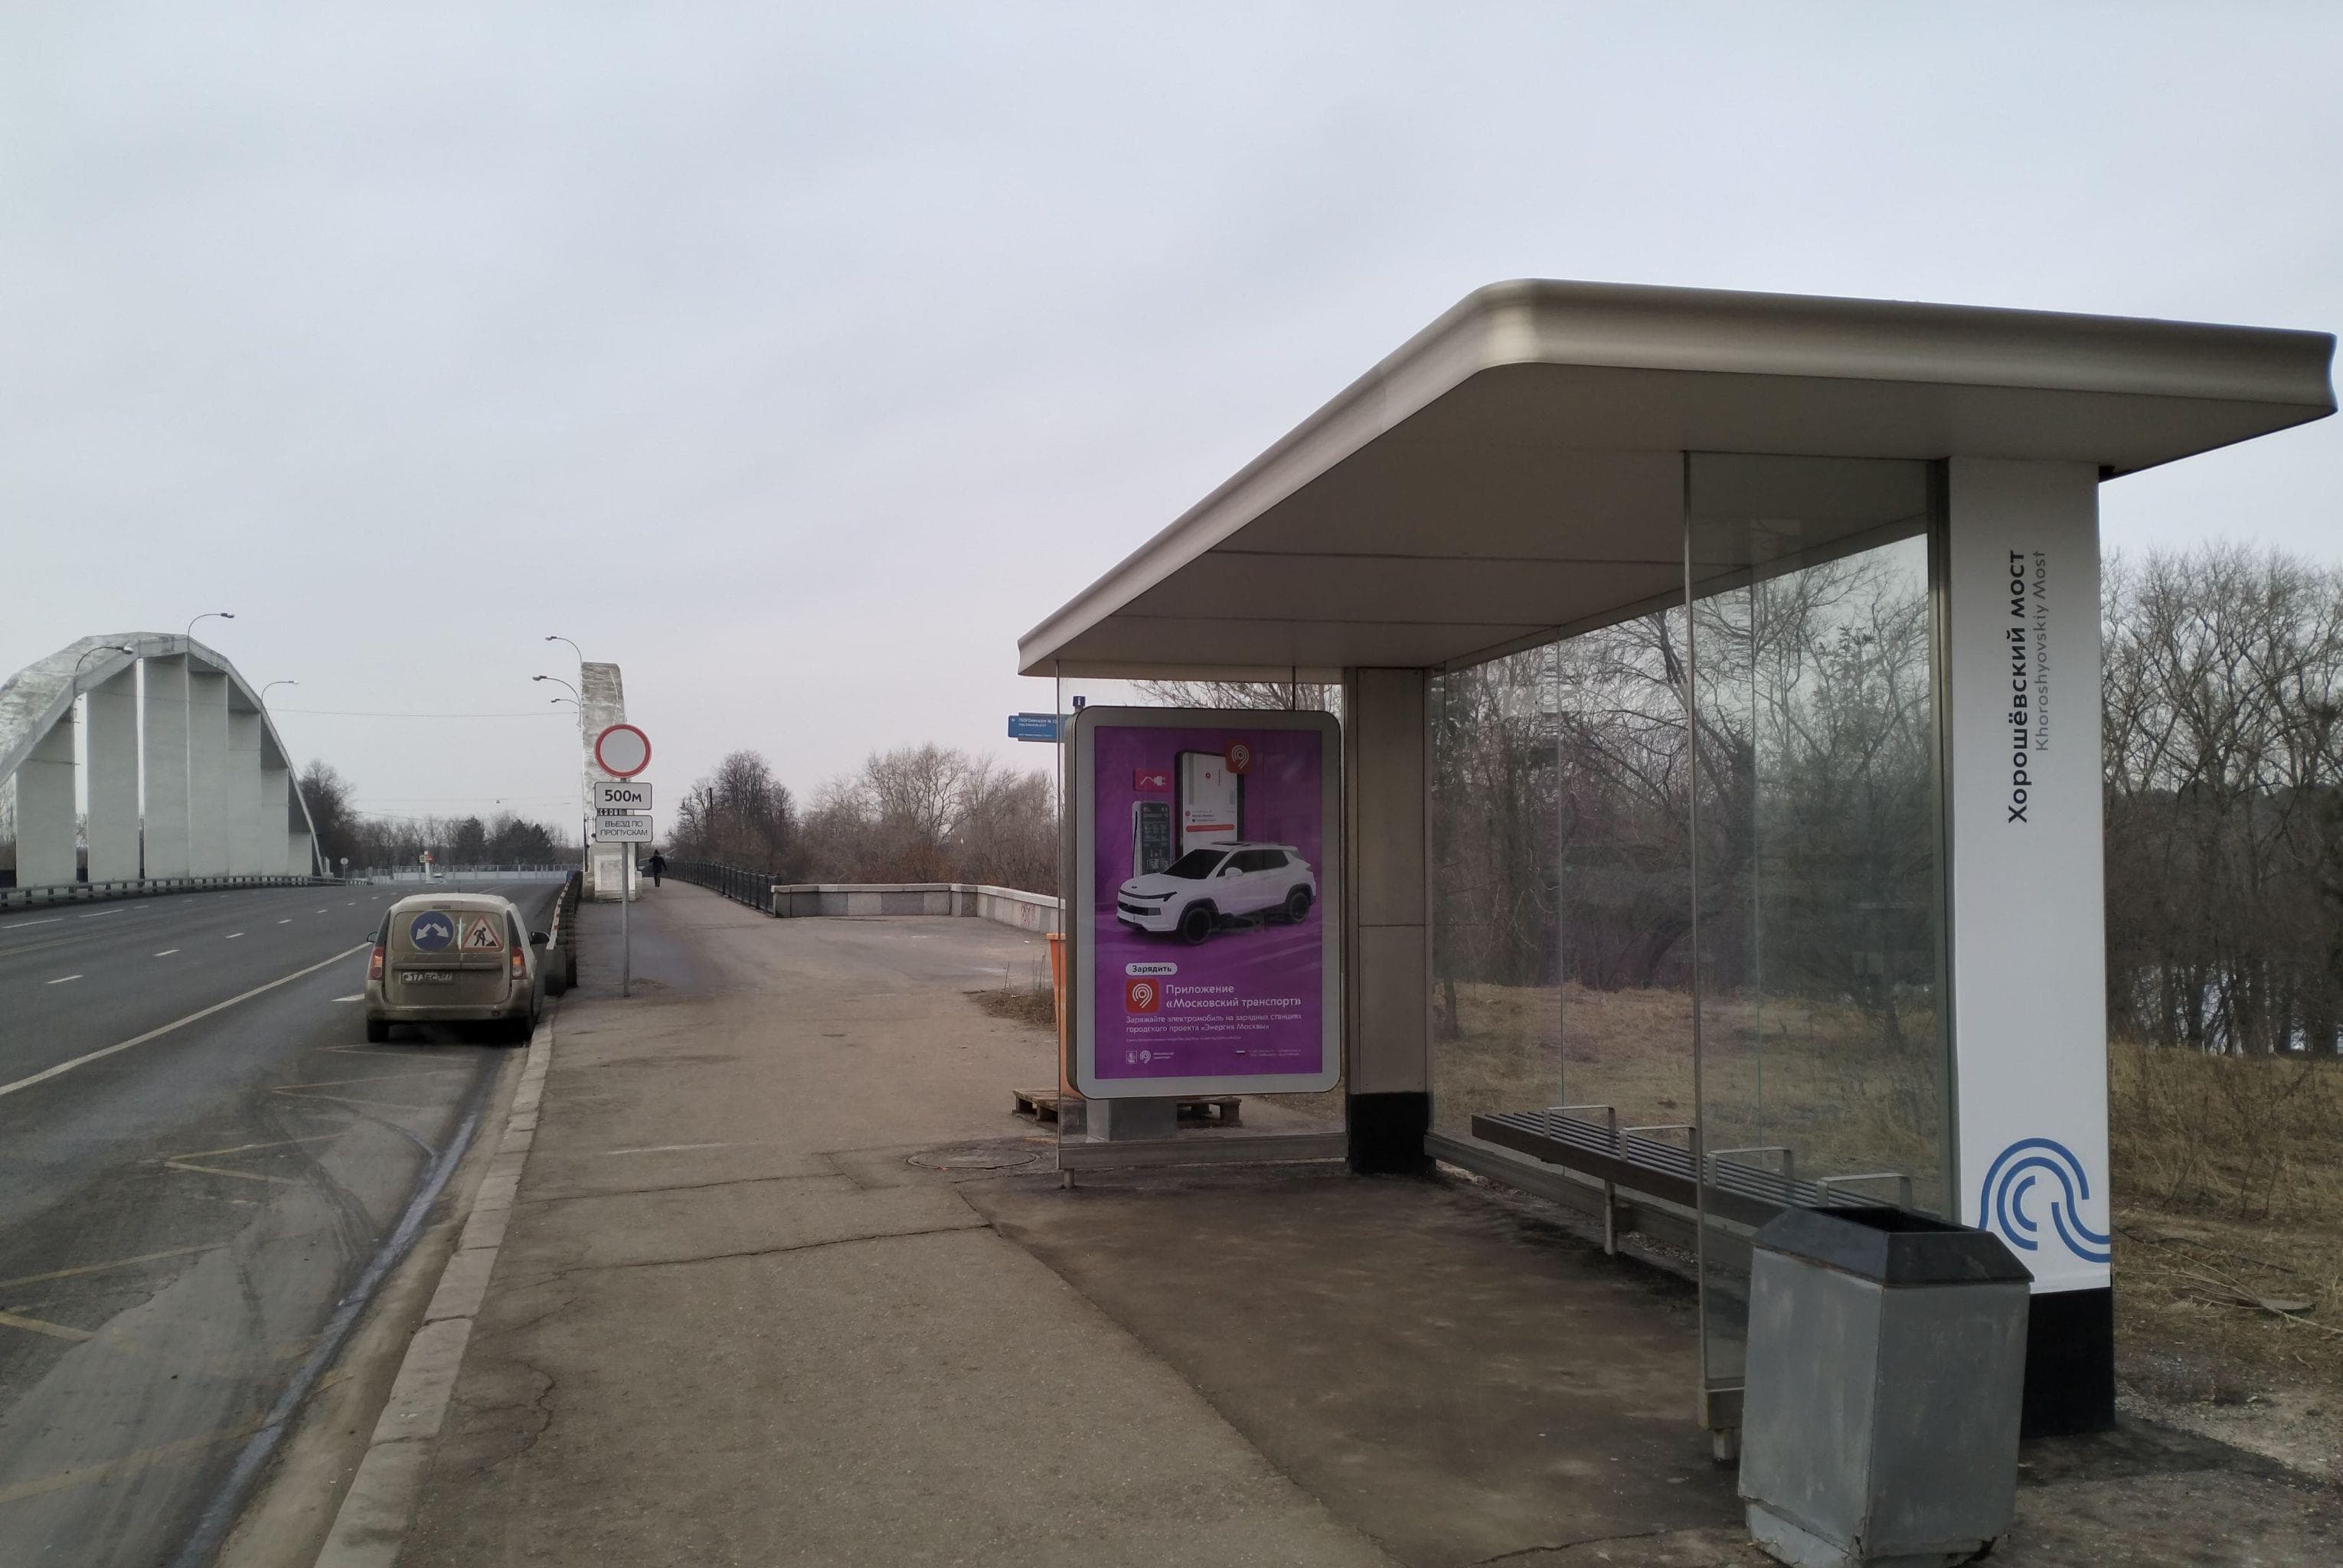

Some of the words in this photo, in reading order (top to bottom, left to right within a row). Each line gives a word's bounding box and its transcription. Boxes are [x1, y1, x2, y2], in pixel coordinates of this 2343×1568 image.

[2010, 550, 2025, 618] мост
[2033, 551, 2046, 599] Most
[2033, 605, 2051, 750] Khoroshyovskiy
[2006, 628, 2032, 823] Хорошёвский
[1132, 965, 1172, 974] Зарядить
[1165, 985, 1234, 995] Приложение
[1165, 998, 1239, 1008] «Московский
[1242, 998, 1302, 1008] транспорт»
[1126, 1016, 1165, 1024] Заряжайте
[1167, 1014, 1224, 1024] электромобиль
